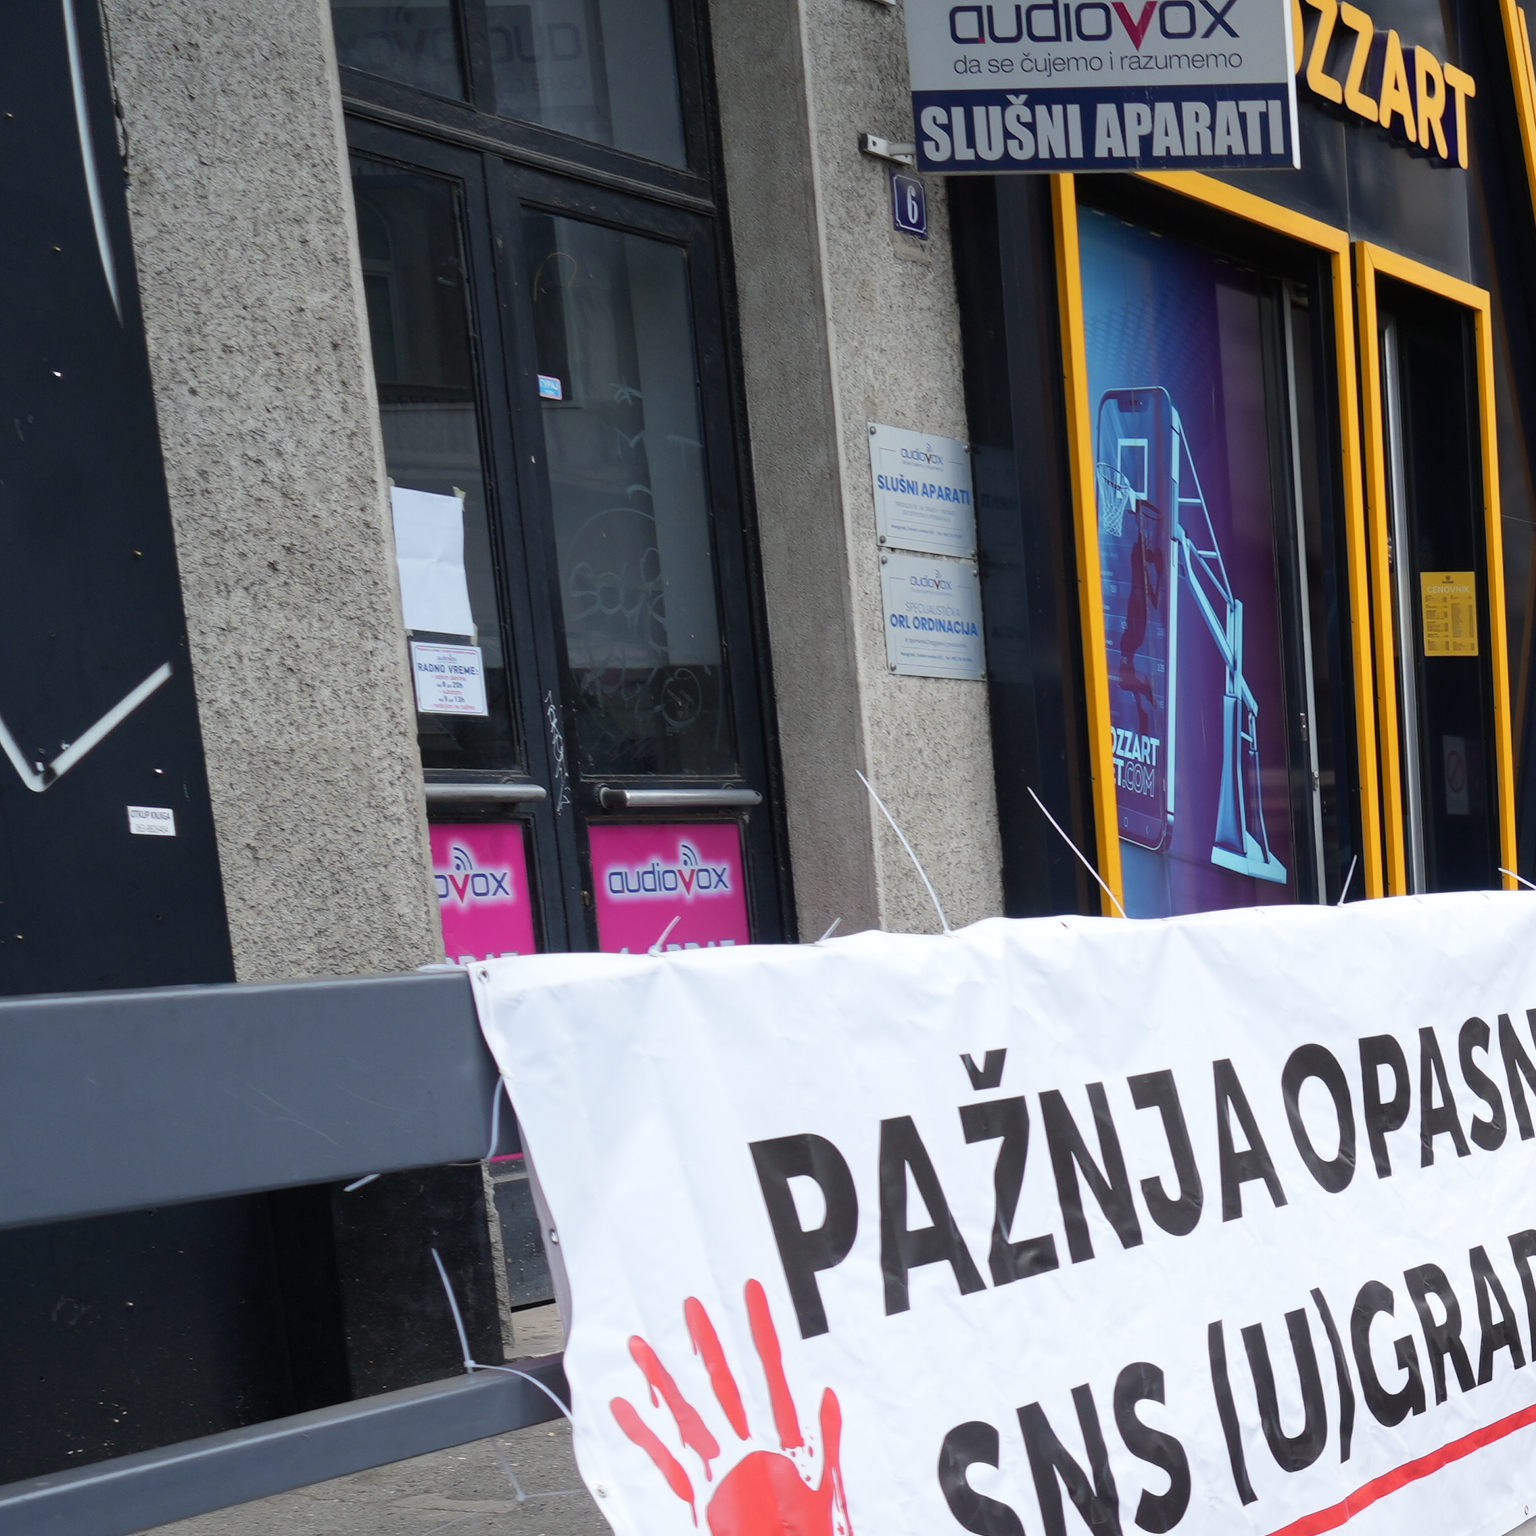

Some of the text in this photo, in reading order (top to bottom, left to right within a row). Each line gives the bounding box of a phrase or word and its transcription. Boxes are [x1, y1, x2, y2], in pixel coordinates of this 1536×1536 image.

[954, 51, 1243, 77] da se čujemo i razumemo
[1291, 0, 1476, 169] ZZART
[920, 94, 1285, 162] SLUŠNI APARATI
[907, 185, 918, 224] 6
[901, 448, 943, 465] audiovox
[877, 474, 971, 506] SLUŠNI APARATI
[890, 613, 979, 637] ORL ORDINACIJA
[418, 663, 445, 673] RADNO
[1113, 757, 1155, 797] T.COM
[608, 863, 728, 895] audiovox
[746, 1048, 1286, 1339] PAŽNJA
